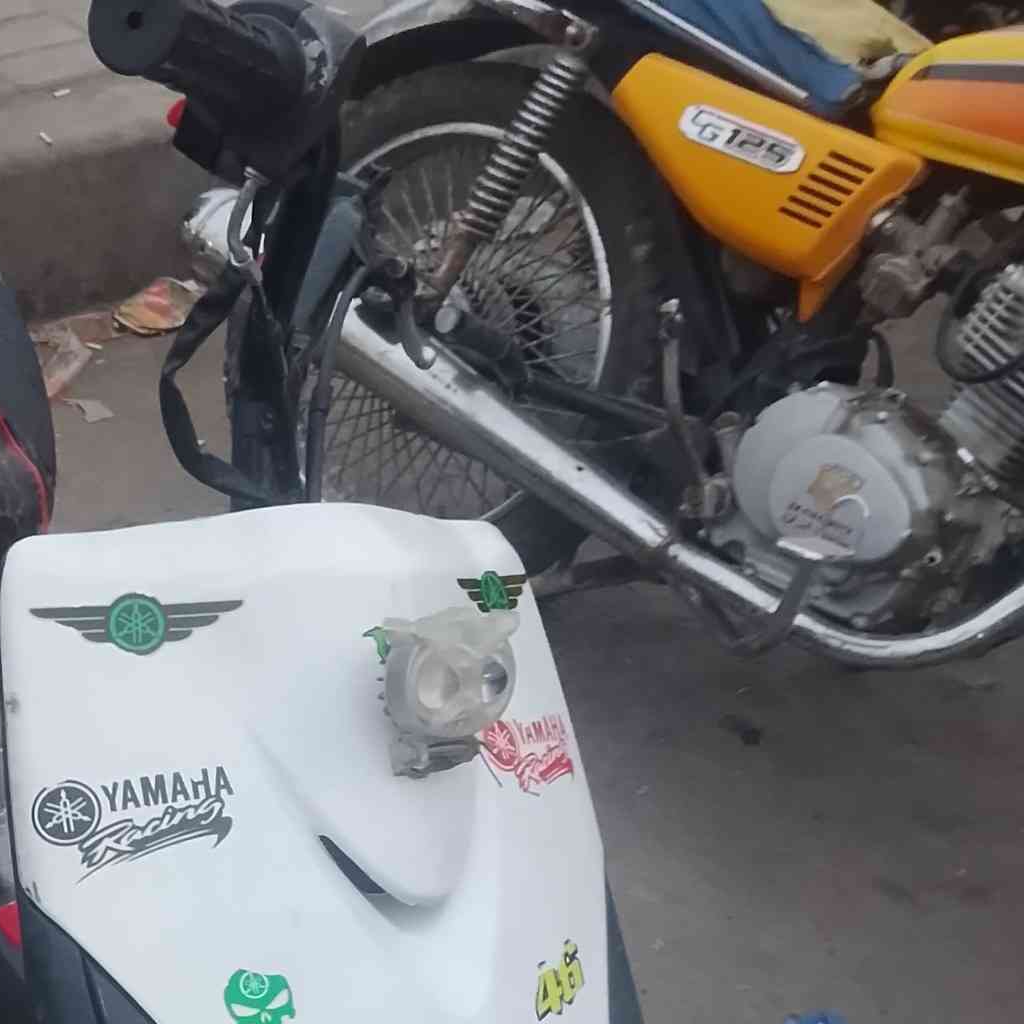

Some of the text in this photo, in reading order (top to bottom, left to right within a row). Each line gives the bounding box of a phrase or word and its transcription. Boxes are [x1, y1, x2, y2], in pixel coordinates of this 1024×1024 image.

[101, 766, 234, 811] YAMAHA
[77, 796, 233, 878] Racing
[535, 938, 584, 1021] 46
